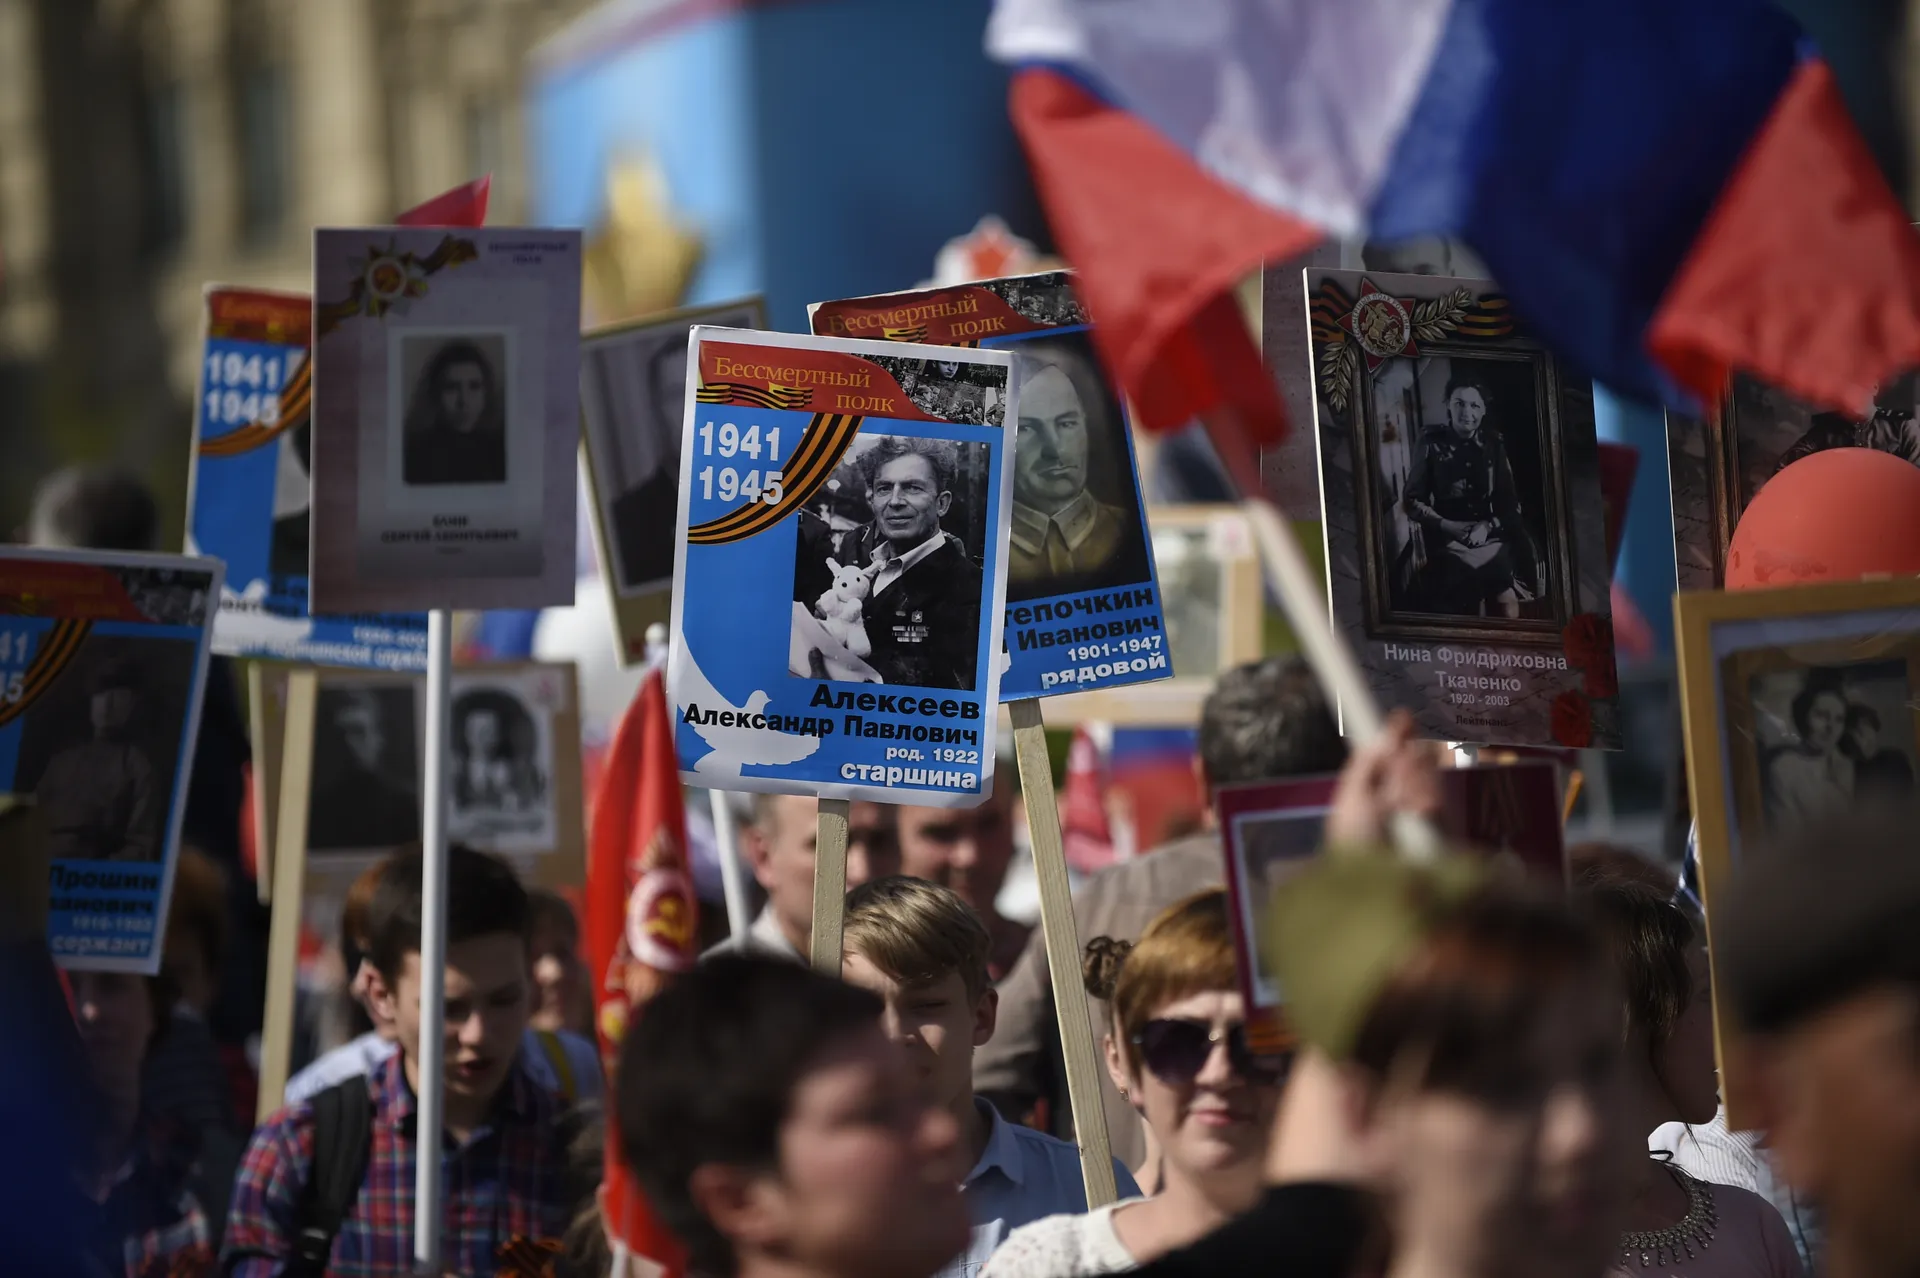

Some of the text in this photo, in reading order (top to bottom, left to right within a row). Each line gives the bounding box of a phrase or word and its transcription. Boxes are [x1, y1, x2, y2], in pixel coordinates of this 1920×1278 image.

[828, 293, 979, 332] Бессмертный
[950, 316, 1006, 338] полк
[205, 350, 280, 388] 1941
[712, 356, 872, 390] Бессмертный
[204, 390, 281, 428] 1945
[836, 394, 895, 413] полк
[699, 421, 780, 461] 1941
[699, 466, 784, 506] 1945
[1016, 615, 1160, 651] Иванович
[1067, 635, 1162, 662] 1901-1947
[1041, 651, 1167, 690] рядовой
[1384, 643, 1568, 671] Нина Фридриховна
[1434, 670, 1522, 692] Ткаченко
[809, 683, 981, 720] Алексеев
[1450, 693, 1475, 704] 1920
[1485, 695, 1510, 706] 2003
[683, 703, 978, 746] Александр Павлович
[886, 746, 979, 765] род. 1922
[840, 762, 979, 789] старшина
[50, 864, 158, 891] Прошин
[51, 935, 150, 956] сержант
